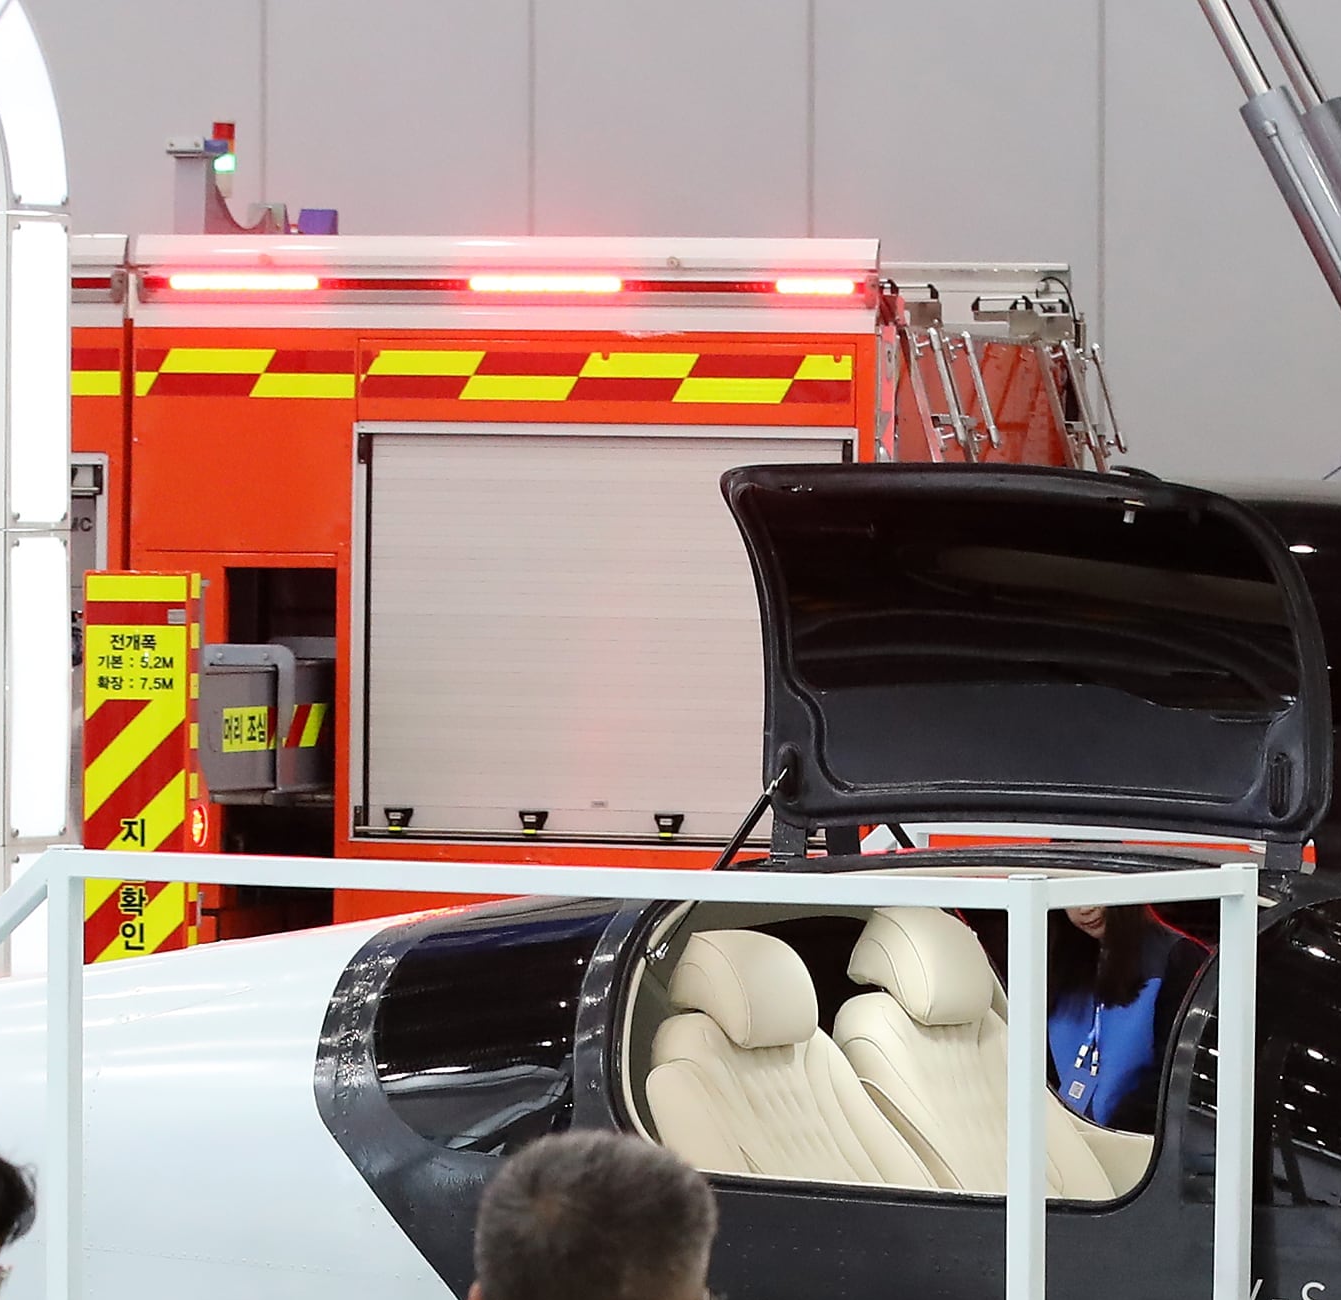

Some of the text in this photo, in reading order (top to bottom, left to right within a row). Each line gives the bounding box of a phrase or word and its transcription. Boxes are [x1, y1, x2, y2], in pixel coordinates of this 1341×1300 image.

[110, 634, 157, 651] 전개폭
[97, 656, 124, 670] 기본
[140, 655, 174, 670] 5.2M
[96, 676, 124, 690] 확장
[140, 677, 174, 690] 7.5M
[247, 712, 267, 742] 조심
[119, 818, 147, 951] 지확인
